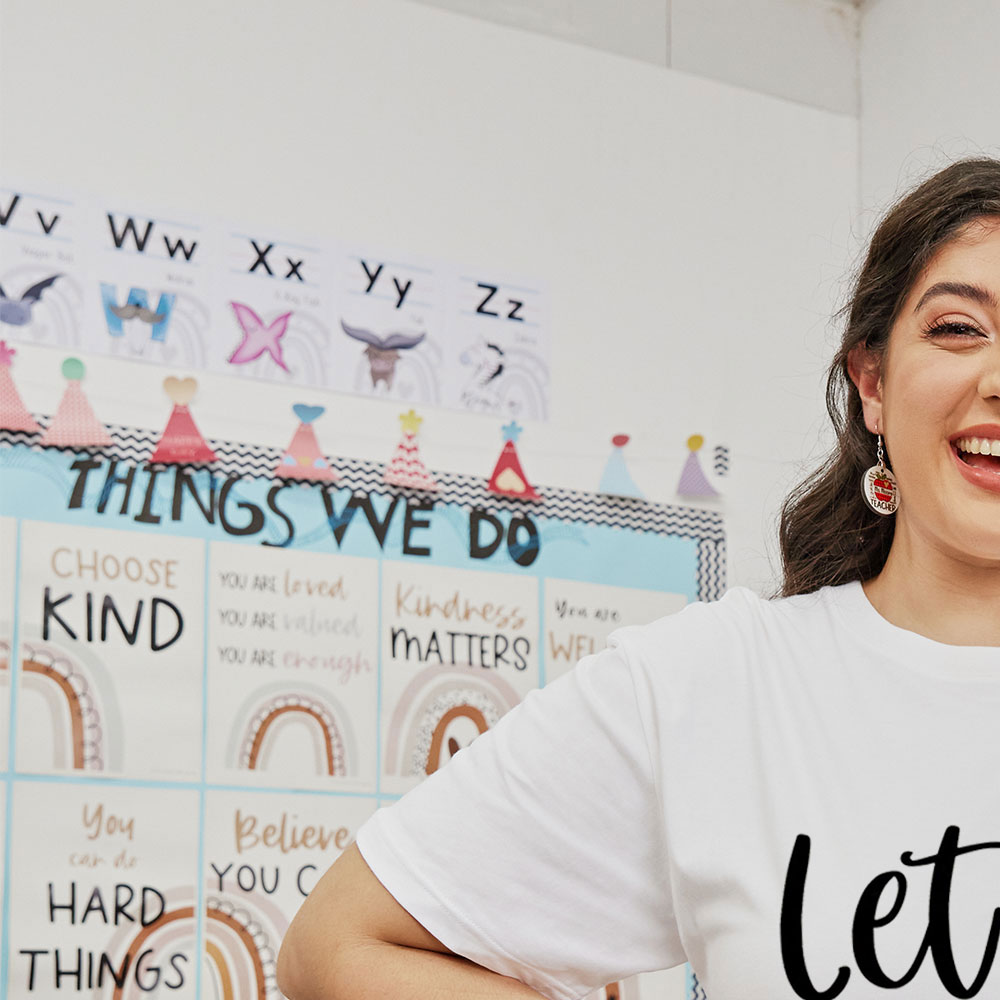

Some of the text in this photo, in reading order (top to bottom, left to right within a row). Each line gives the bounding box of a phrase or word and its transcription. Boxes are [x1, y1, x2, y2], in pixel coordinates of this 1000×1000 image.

[68, 458, 541, 567] THINGS WE DO
[51, 548, 179, 590] CHOOSE
[219, 568, 347, 601] YOU ARE loved
[43, 586, 184, 652] KIND
[218, 608, 248, 627] YOU
[252, 611, 277, 631] ARE
[395, 581, 527, 630] Kindness
[555, 599, 588, 620] You
[218, 645, 248, 664] YOU
[252, 649, 276, 668] ARE
[83, 803, 135, 841] You
[234, 808, 350, 855] Believe
[211, 863, 279, 894] YOU
[48, 881, 166, 928] HARD
[19, 948, 189, 992] THINGS
